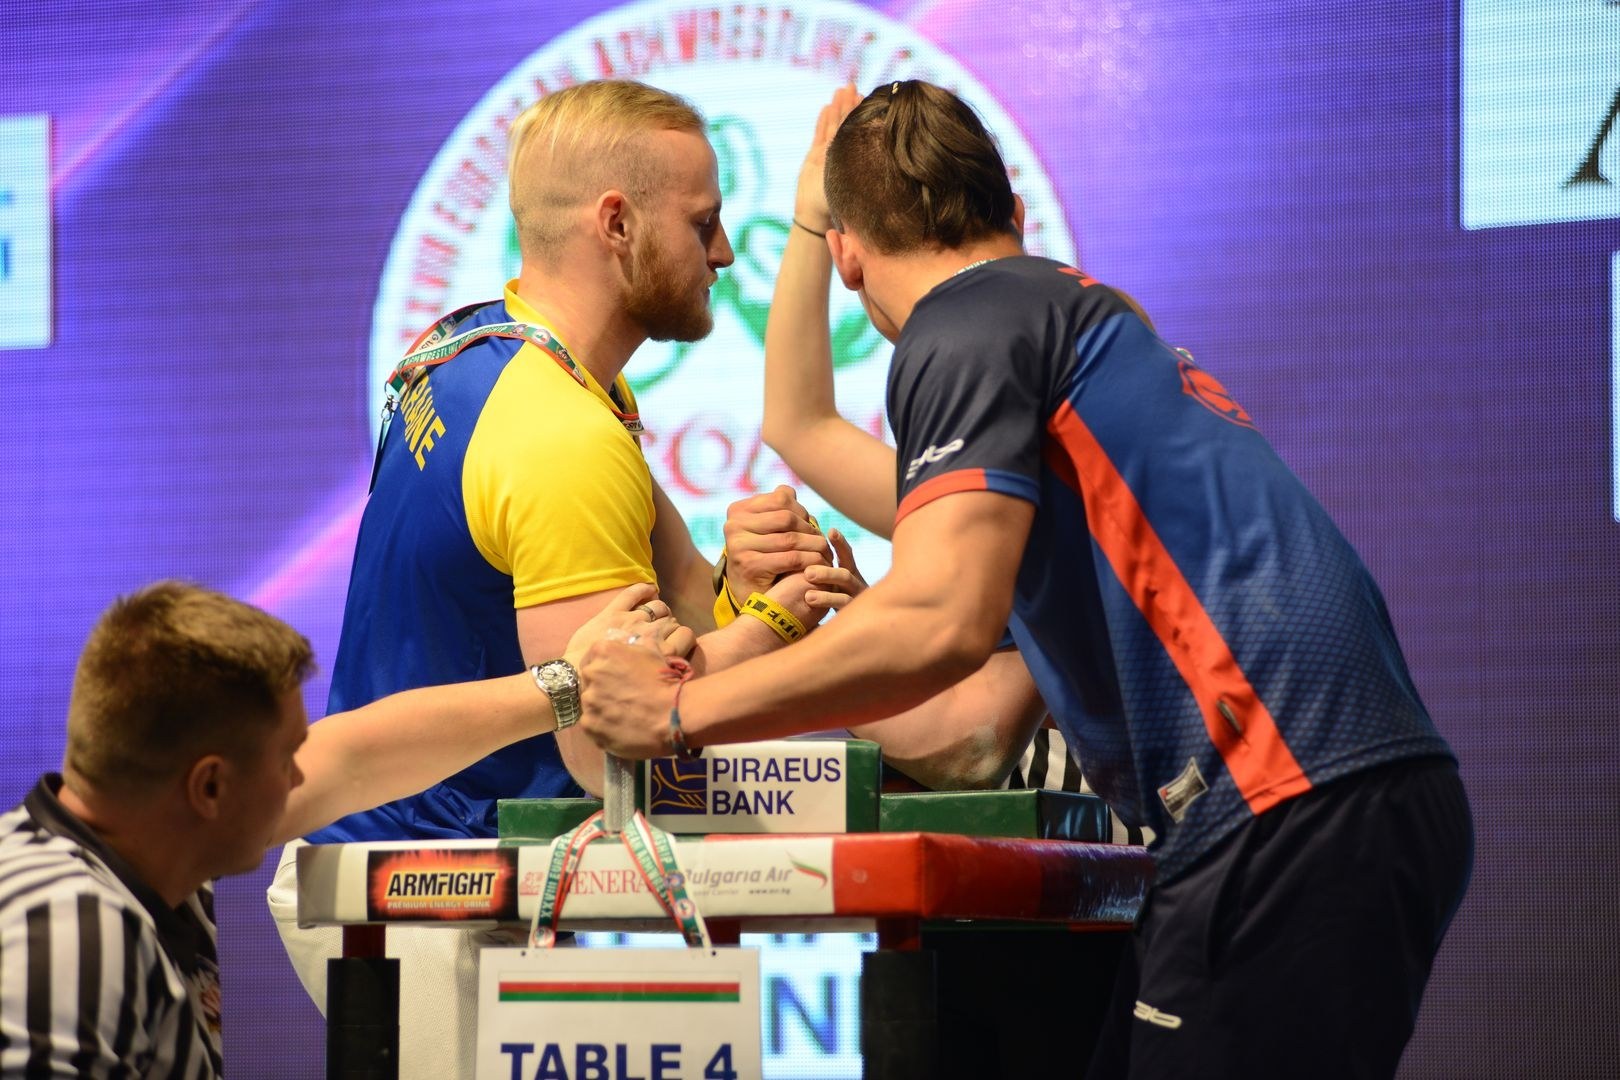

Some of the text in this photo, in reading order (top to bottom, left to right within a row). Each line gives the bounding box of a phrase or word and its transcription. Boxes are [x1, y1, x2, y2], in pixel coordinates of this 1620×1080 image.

[400, 375, 446, 472] RAINE
[712, 757, 841, 783] PIRAEUS
[712, 790, 796, 815] BANK
[388, 871, 496, 897] ARMFIGHT
[575, 869, 649, 895] ENERA
[765, 866, 793, 882] Air
[387, 899, 491, 910] PREMIUM ENERGY DRINK
[500, 1043, 738, 1080] TABLE 4
